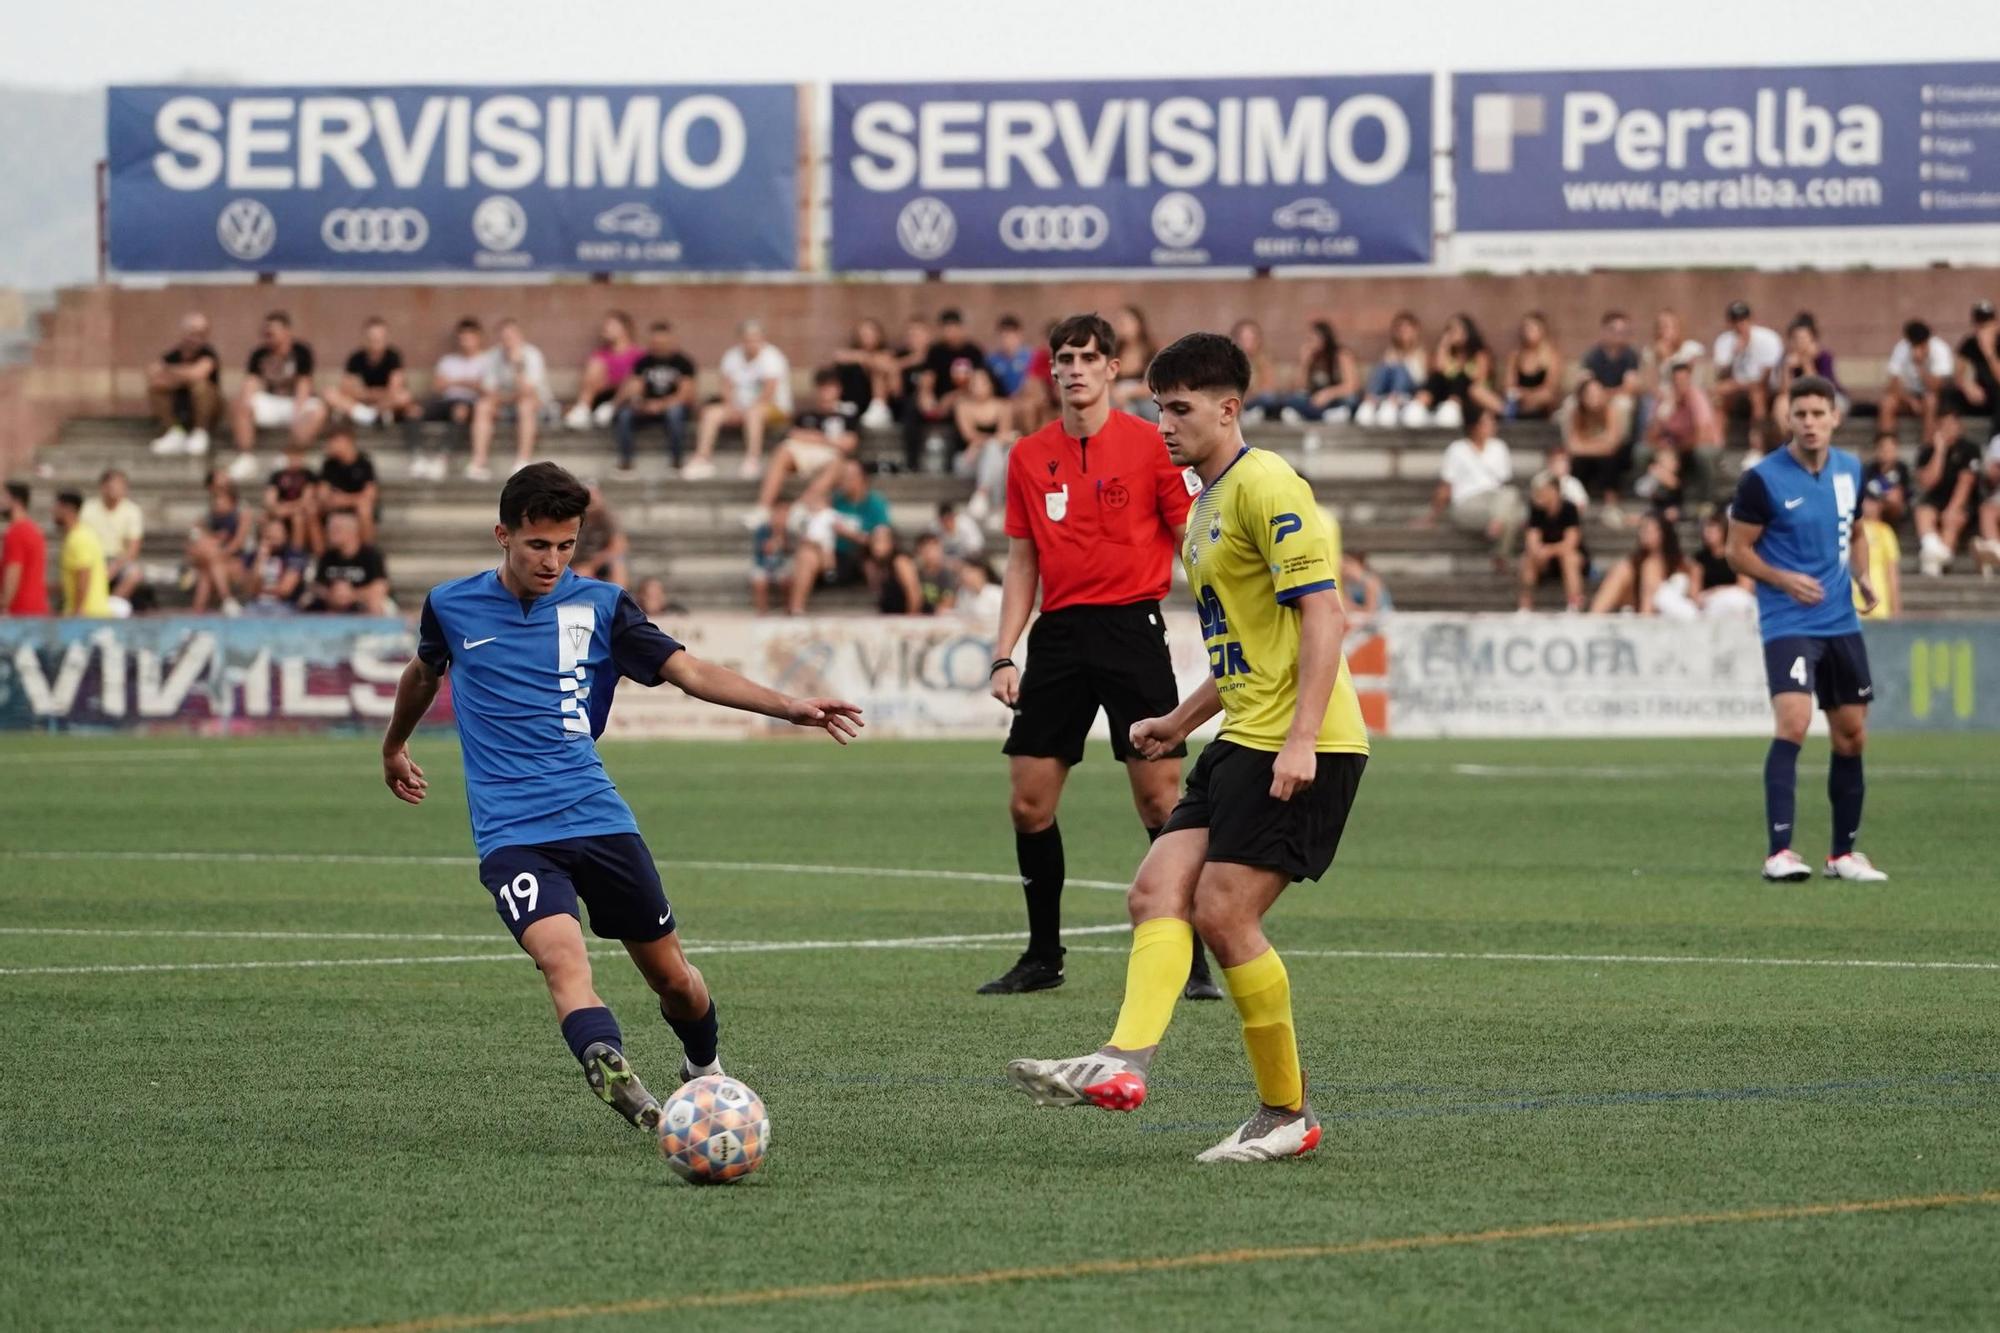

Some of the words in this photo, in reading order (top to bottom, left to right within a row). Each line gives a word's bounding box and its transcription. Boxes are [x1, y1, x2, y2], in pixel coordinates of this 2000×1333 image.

[154, 94, 746, 190] SERVISIMO
[850, 93, 1410, 191] SERVISIMO
[1562, 87, 1882, 172] Peralba
[1562, 174, 1883, 217] www.peralba.com
[1789, 656, 1808, 686] 4
[499, 872, 539, 922] 19
